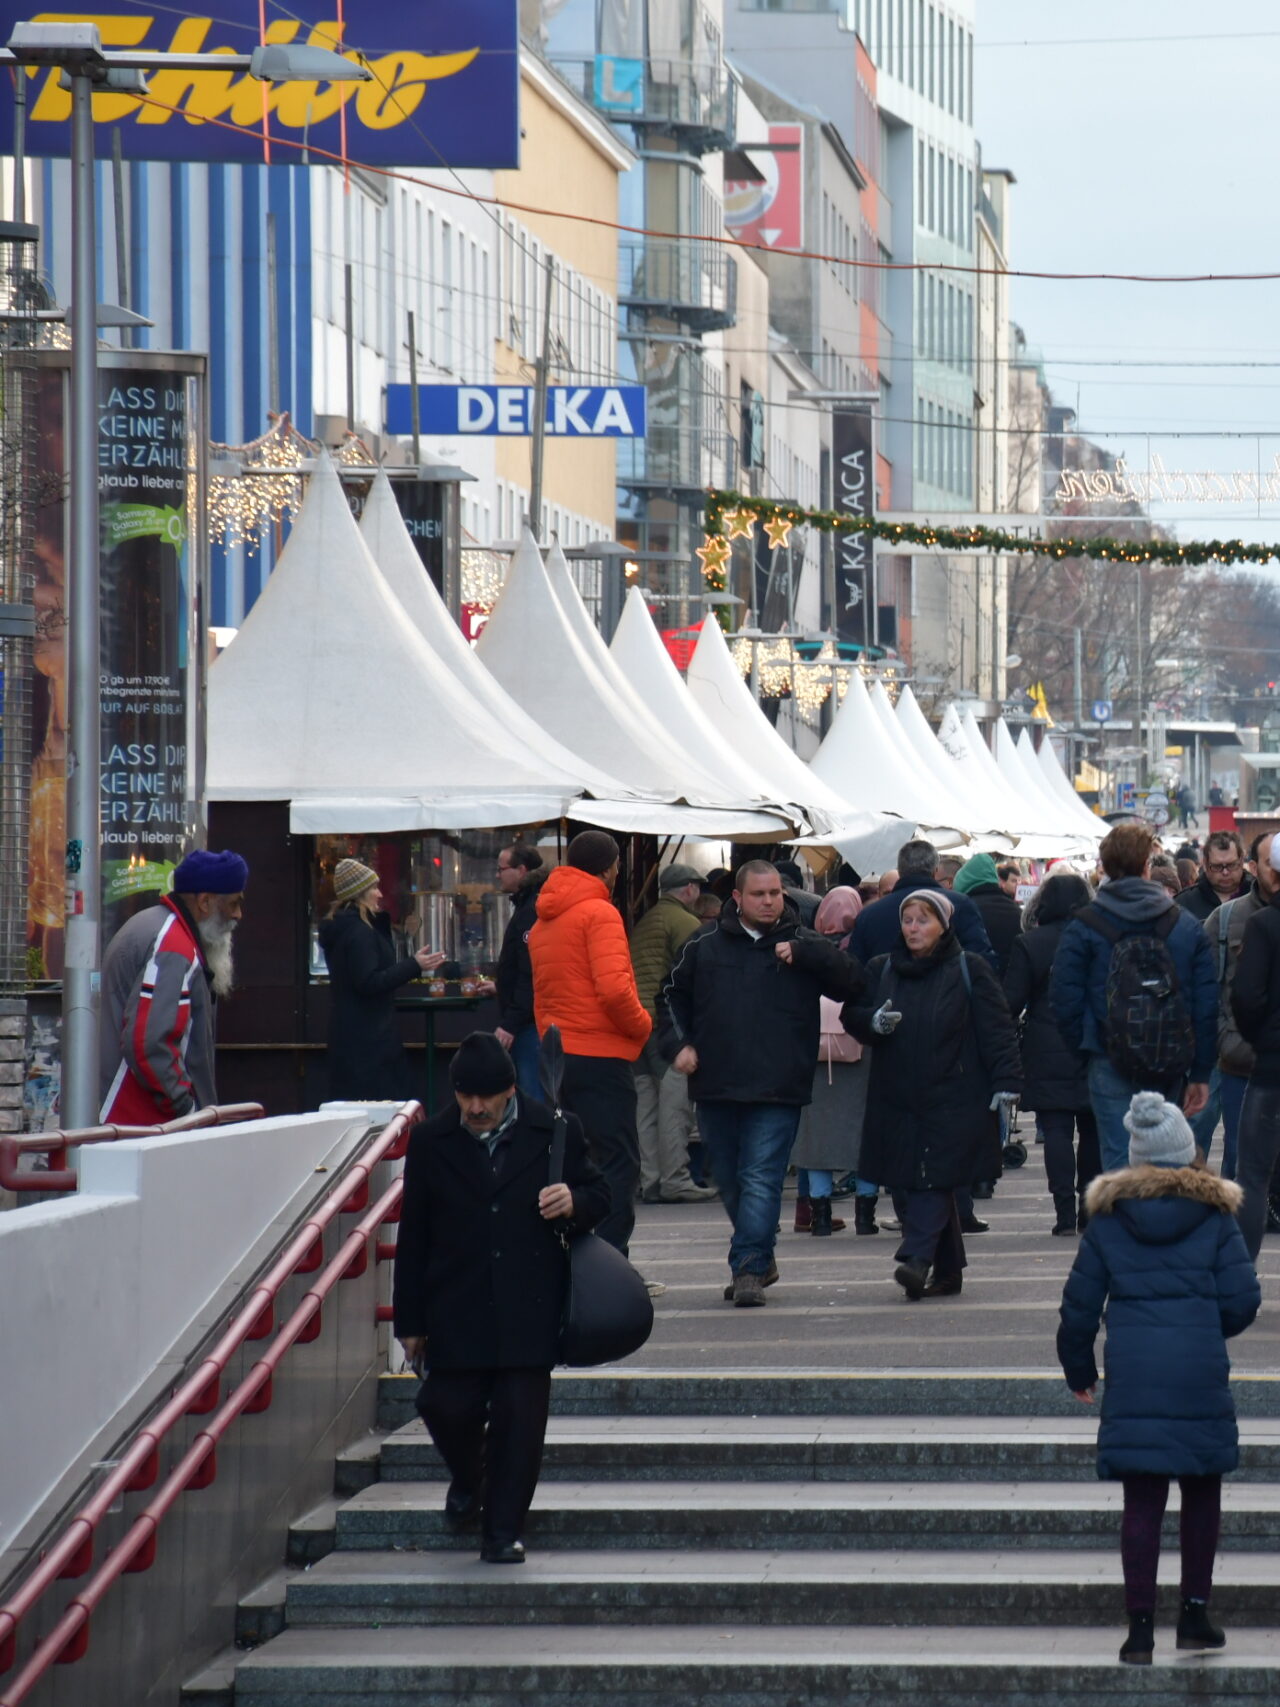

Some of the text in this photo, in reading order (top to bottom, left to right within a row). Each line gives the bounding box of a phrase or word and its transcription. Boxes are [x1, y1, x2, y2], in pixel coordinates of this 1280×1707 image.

[457, 386, 634, 435] DELKA
[142, 474, 174, 489] lieber
[841, 449, 865, 570] KAACA
[99, 687, 152, 698] nbegrenzte
[125, 702, 150, 714] AUF
[141, 831, 174, 844] lieber
